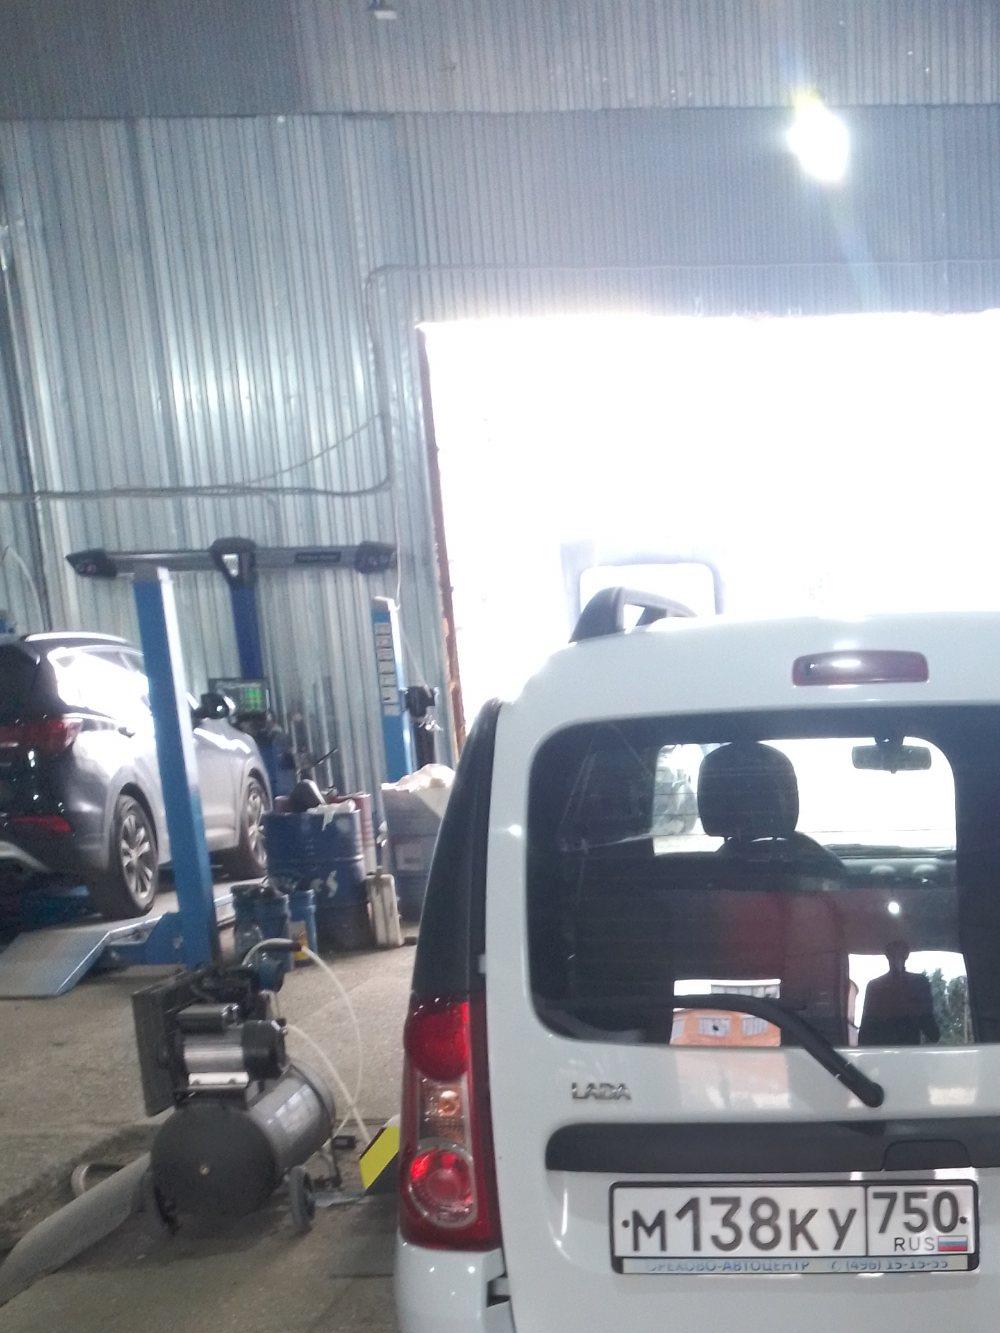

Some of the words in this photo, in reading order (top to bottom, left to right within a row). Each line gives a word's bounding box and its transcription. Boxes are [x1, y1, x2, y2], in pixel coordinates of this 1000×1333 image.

[571, 1081, 633, 1101] LADA
[871, 1190, 961, 1235] 750
[893, 1236, 936, 1252] RUS
